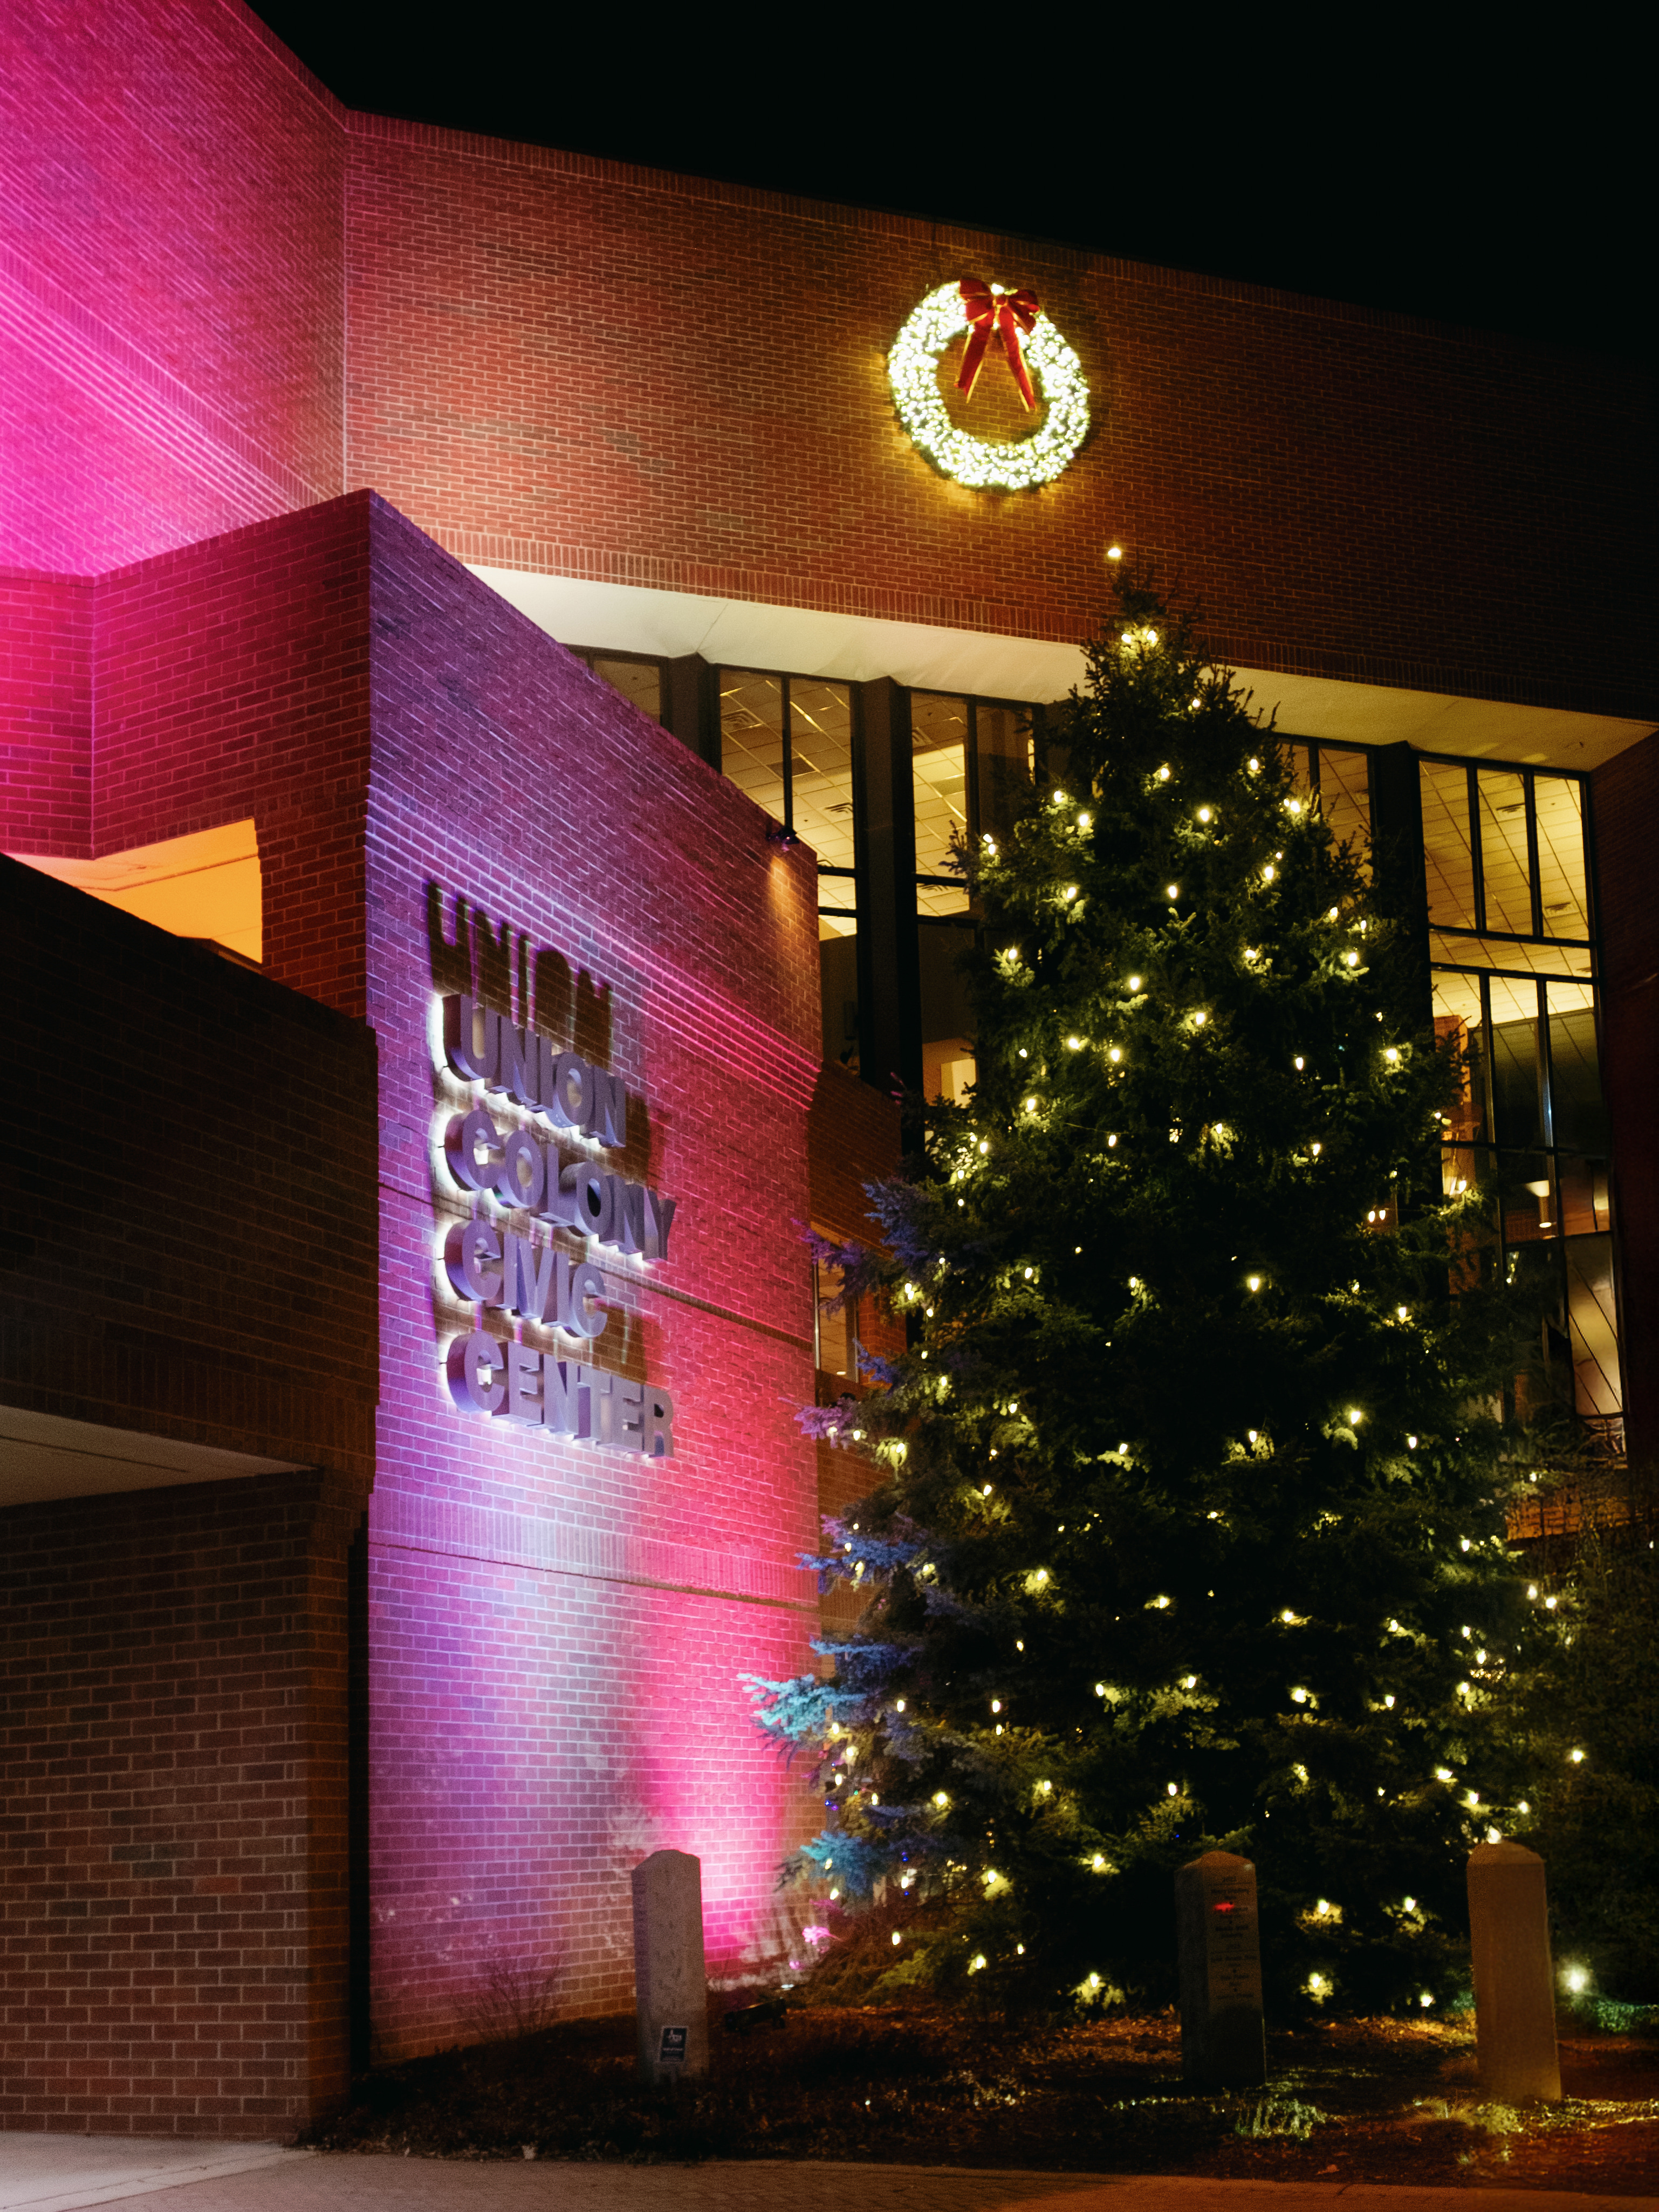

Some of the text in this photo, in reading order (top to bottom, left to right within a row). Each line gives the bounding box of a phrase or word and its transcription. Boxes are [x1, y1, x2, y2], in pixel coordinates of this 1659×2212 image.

[443, 993, 626, 1148] UNION
[444, 1109, 676, 1261] COLONY
[444, 1219, 608, 1338] CIVIC
[447, 1330, 674, 1457] CENTER
